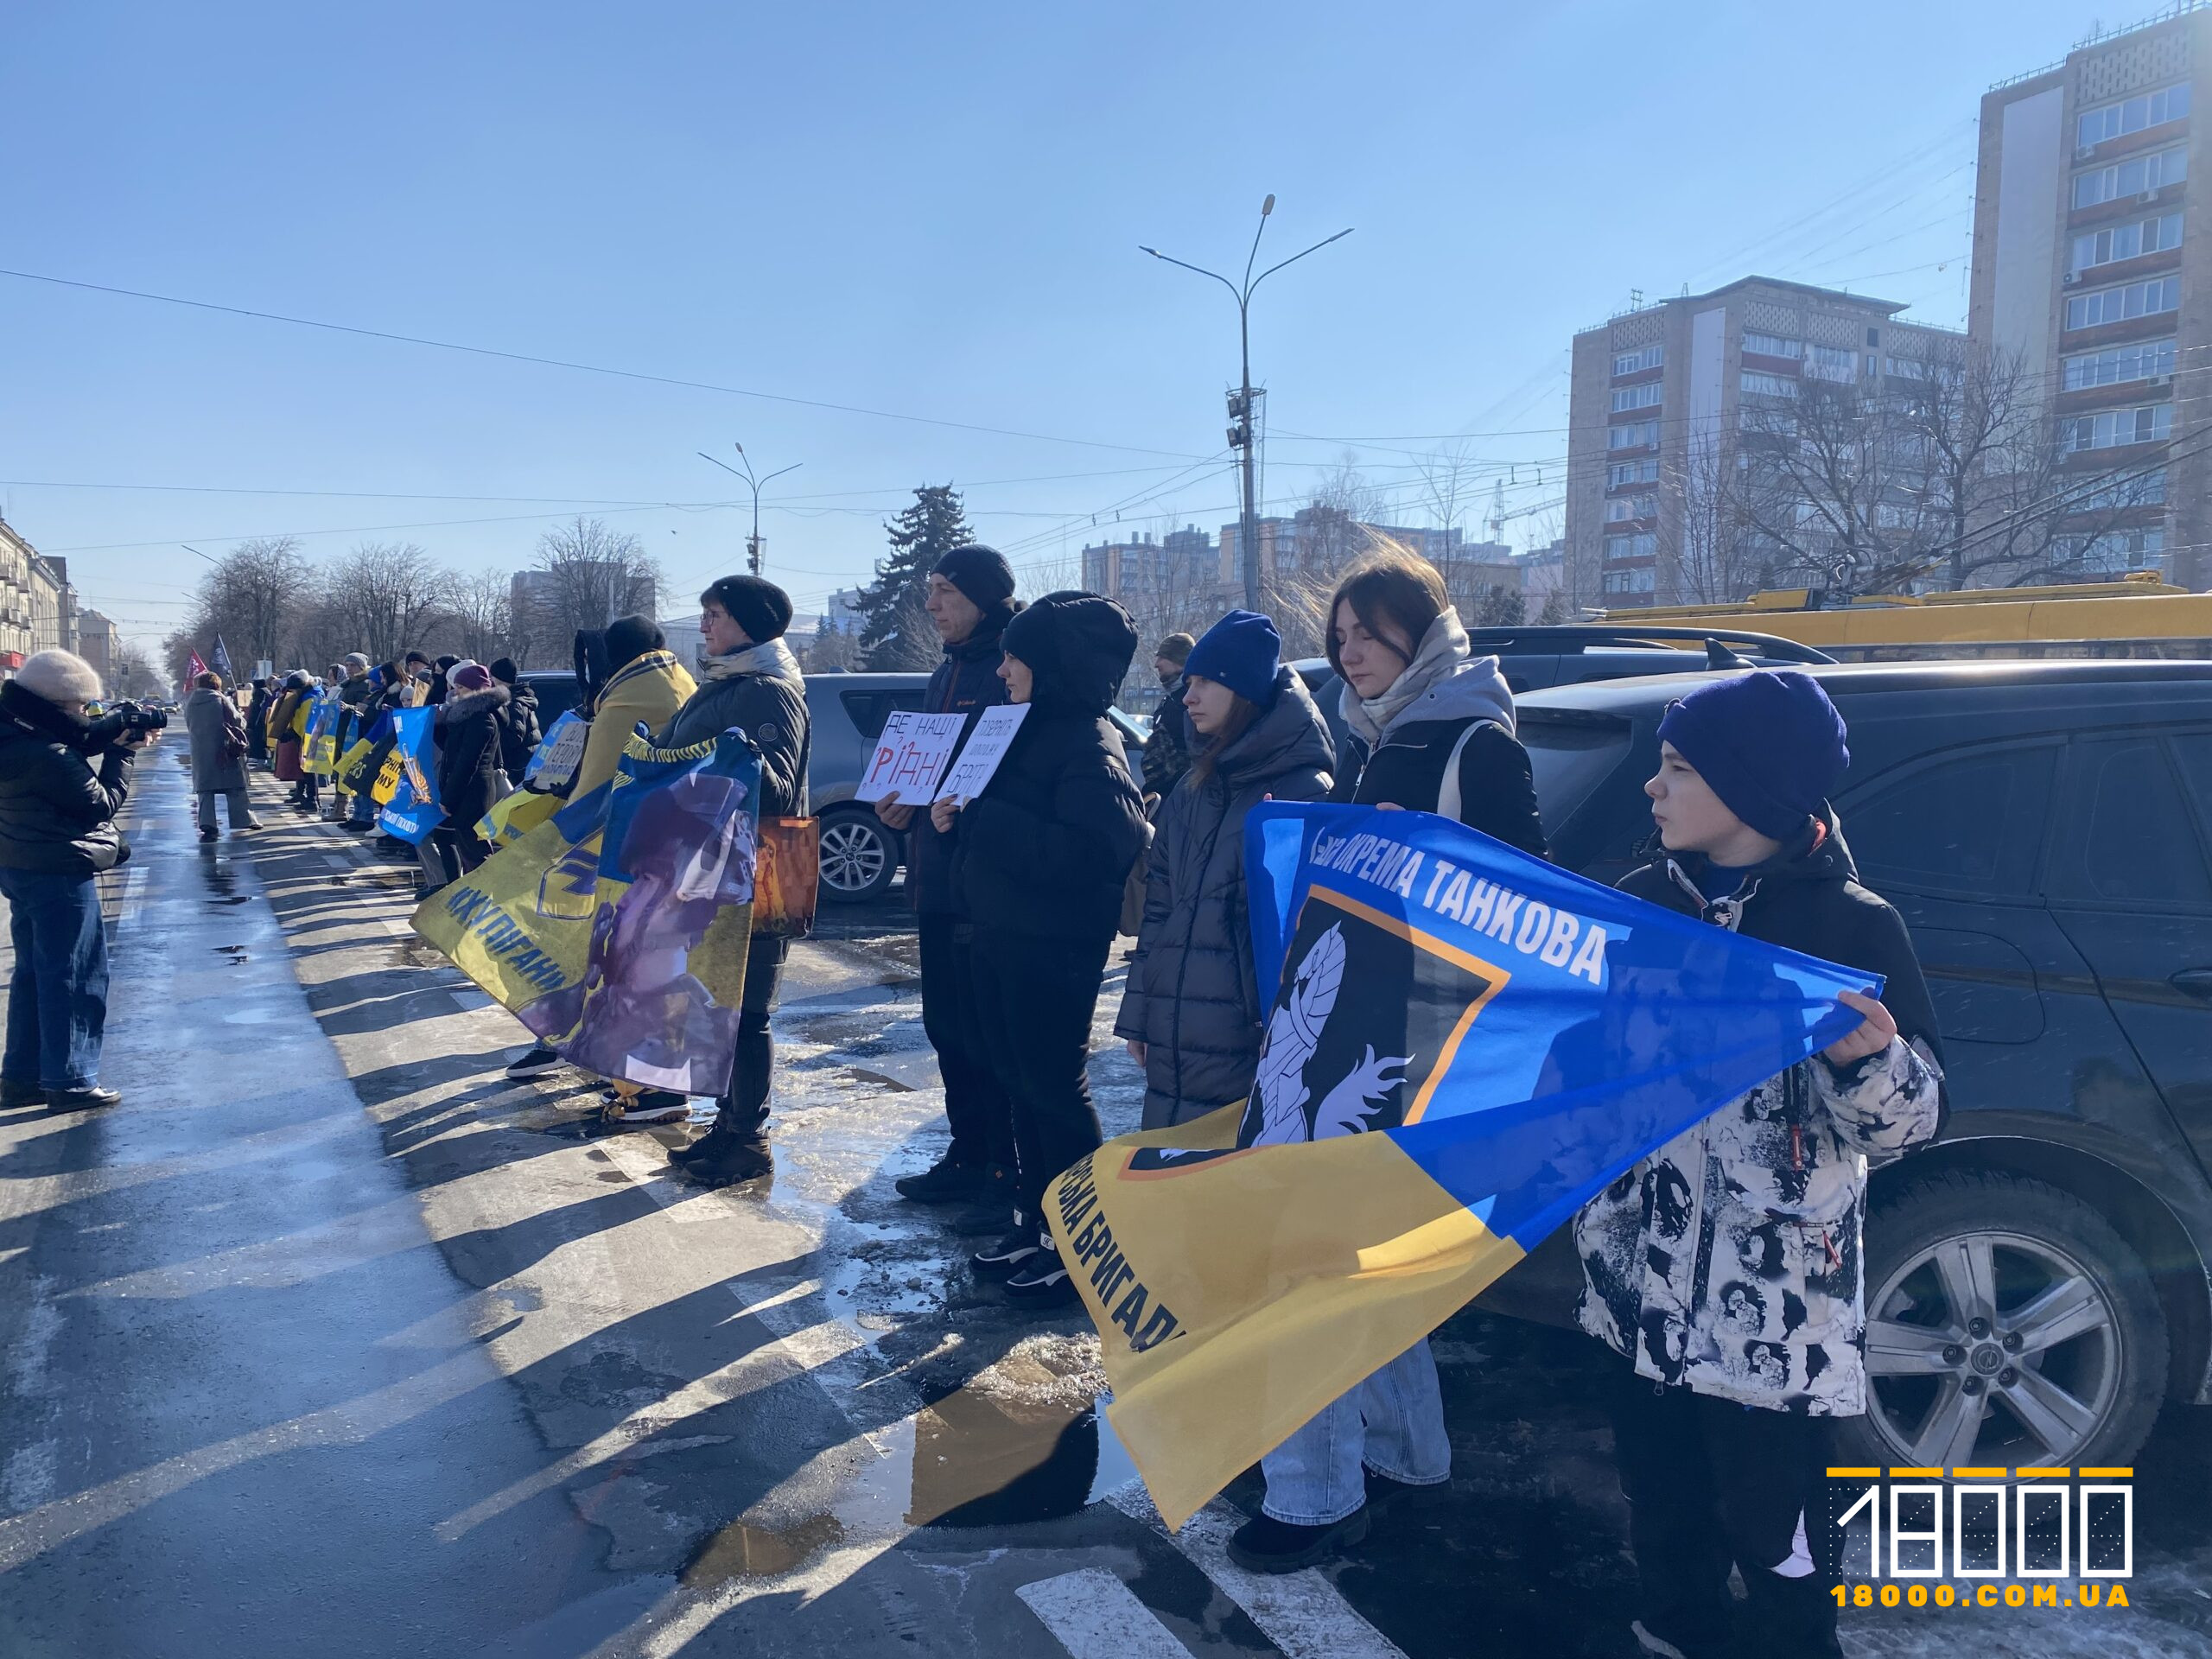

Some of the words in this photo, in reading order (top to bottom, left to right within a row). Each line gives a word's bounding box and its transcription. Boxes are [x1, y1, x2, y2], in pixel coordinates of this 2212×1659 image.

[870, 741, 950, 786] РІДНІ
[884, 715, 912, 737] ДЕ
[915, 716, 957, 735] НАШІ
[1332, 833, 1426, 899] ОКРЕМА
[1422, 859, 1607, 987] ТАНКОВА
[1072, 1211, 1187, 1353] БРИГАД
